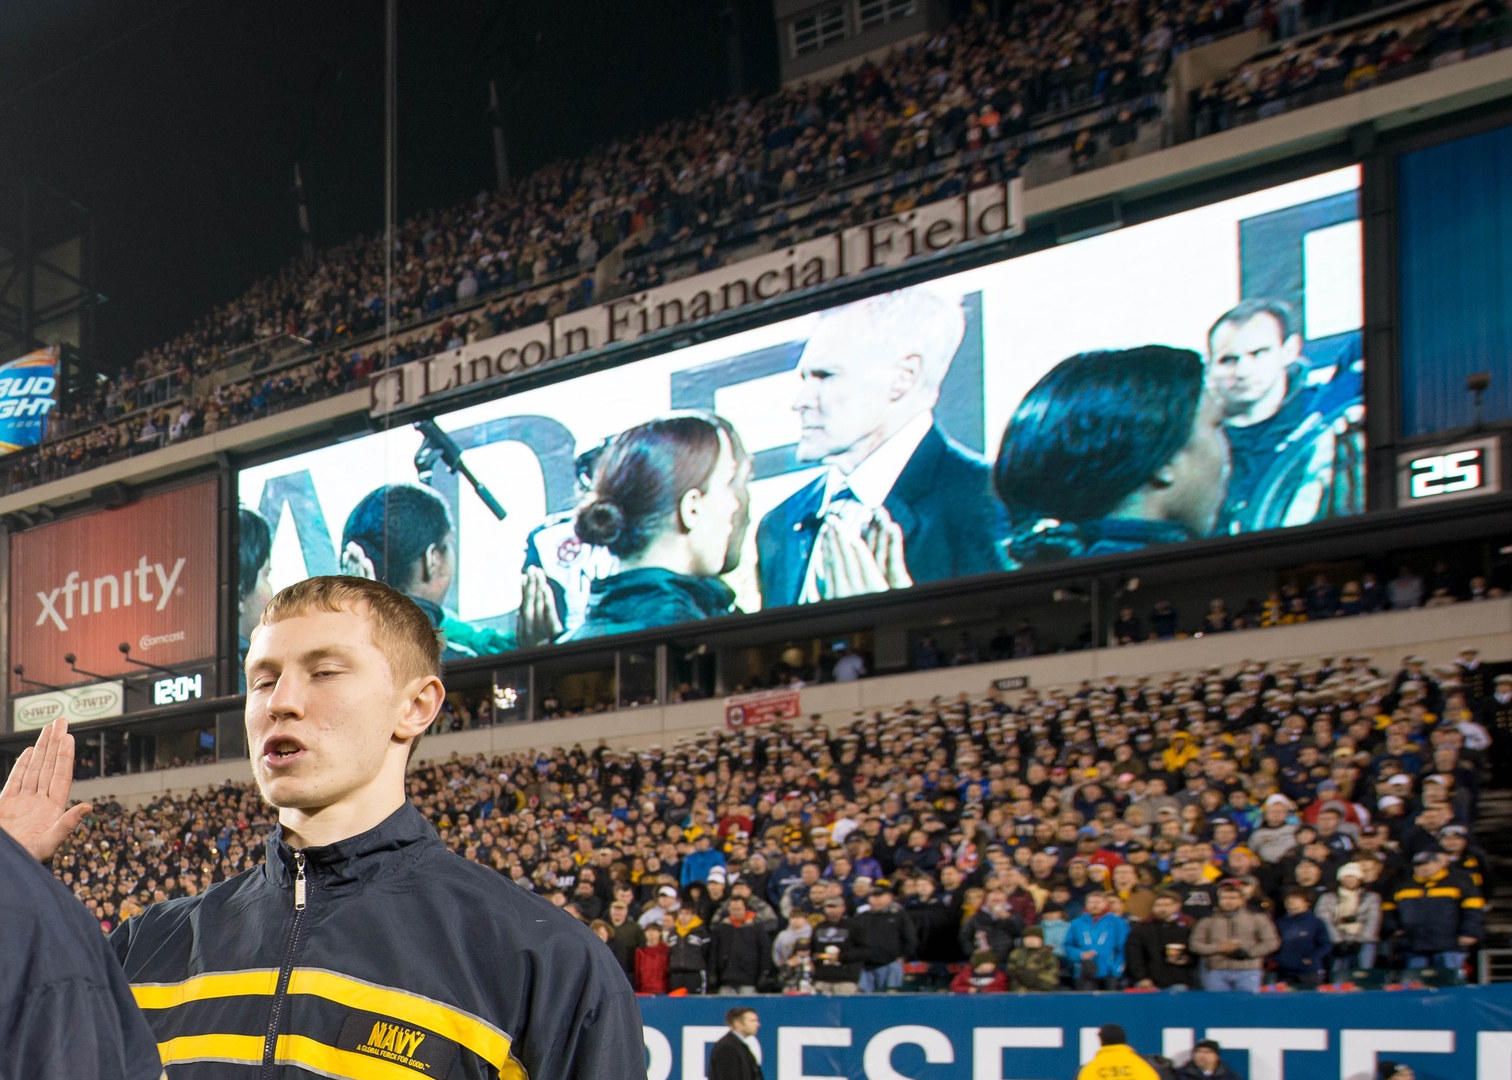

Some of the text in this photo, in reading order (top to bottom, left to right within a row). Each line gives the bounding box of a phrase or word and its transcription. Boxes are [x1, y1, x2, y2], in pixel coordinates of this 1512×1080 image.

[420, 183, 1015, 391] Lincoln Financial Field
[1410, 448, 1482, 499] 25
[35, 555, 186, 632] xfinity
[154, 673, 202, 705] 12:04
[367, 1024, 425, 1058] NAVY
[397, 1055, 409, 1065] FOR
